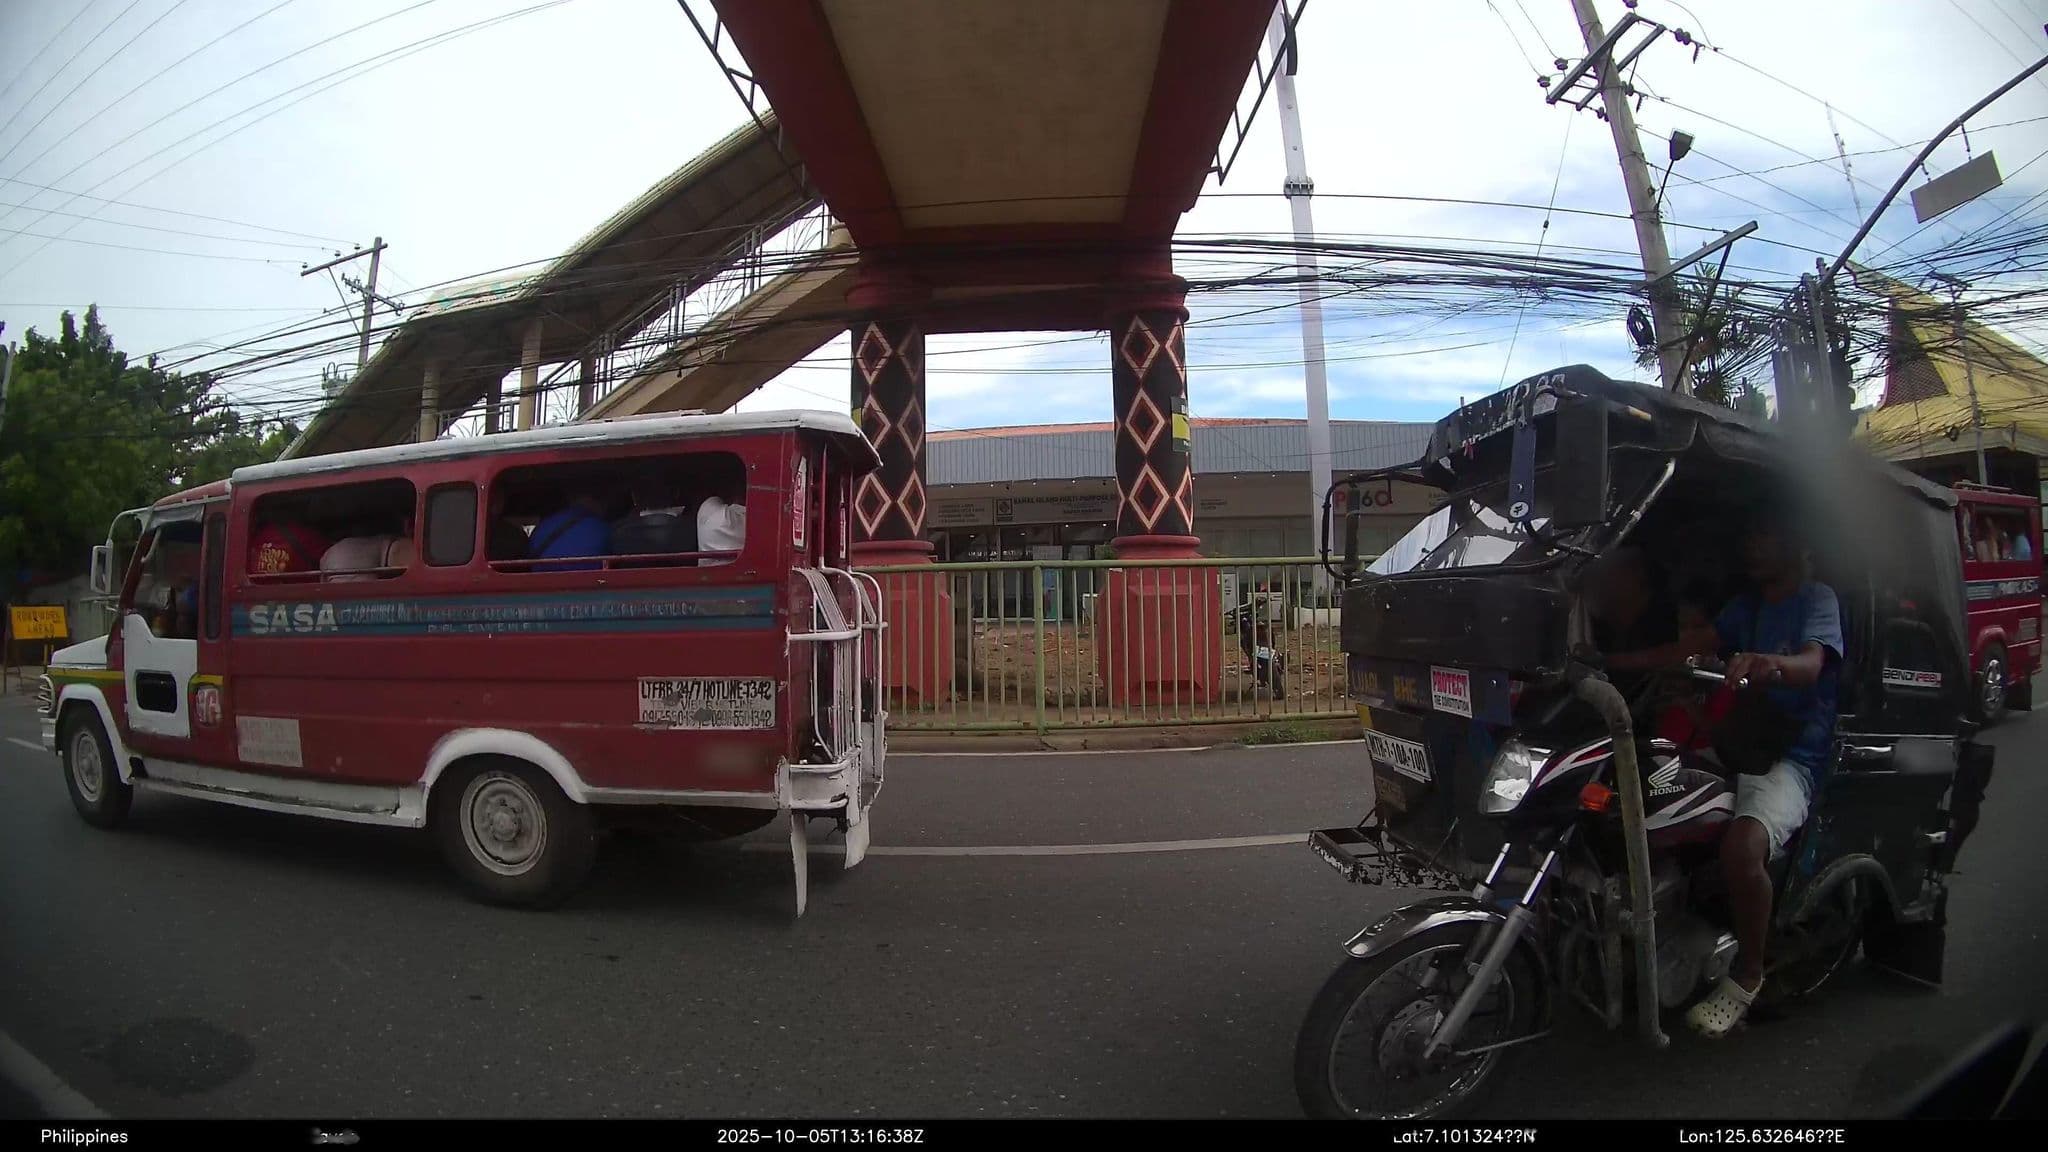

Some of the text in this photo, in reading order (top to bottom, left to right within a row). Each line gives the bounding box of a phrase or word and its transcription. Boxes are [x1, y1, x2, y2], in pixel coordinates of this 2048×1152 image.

[250, 603, 339, 633] SASA
[642, 680, 674, 699] LTFRB
[676, 681, 702, 699] 24/7
[1433, 670, 1468, 698] PROTECT
[1649, 784, 1686, 797] HONDA
